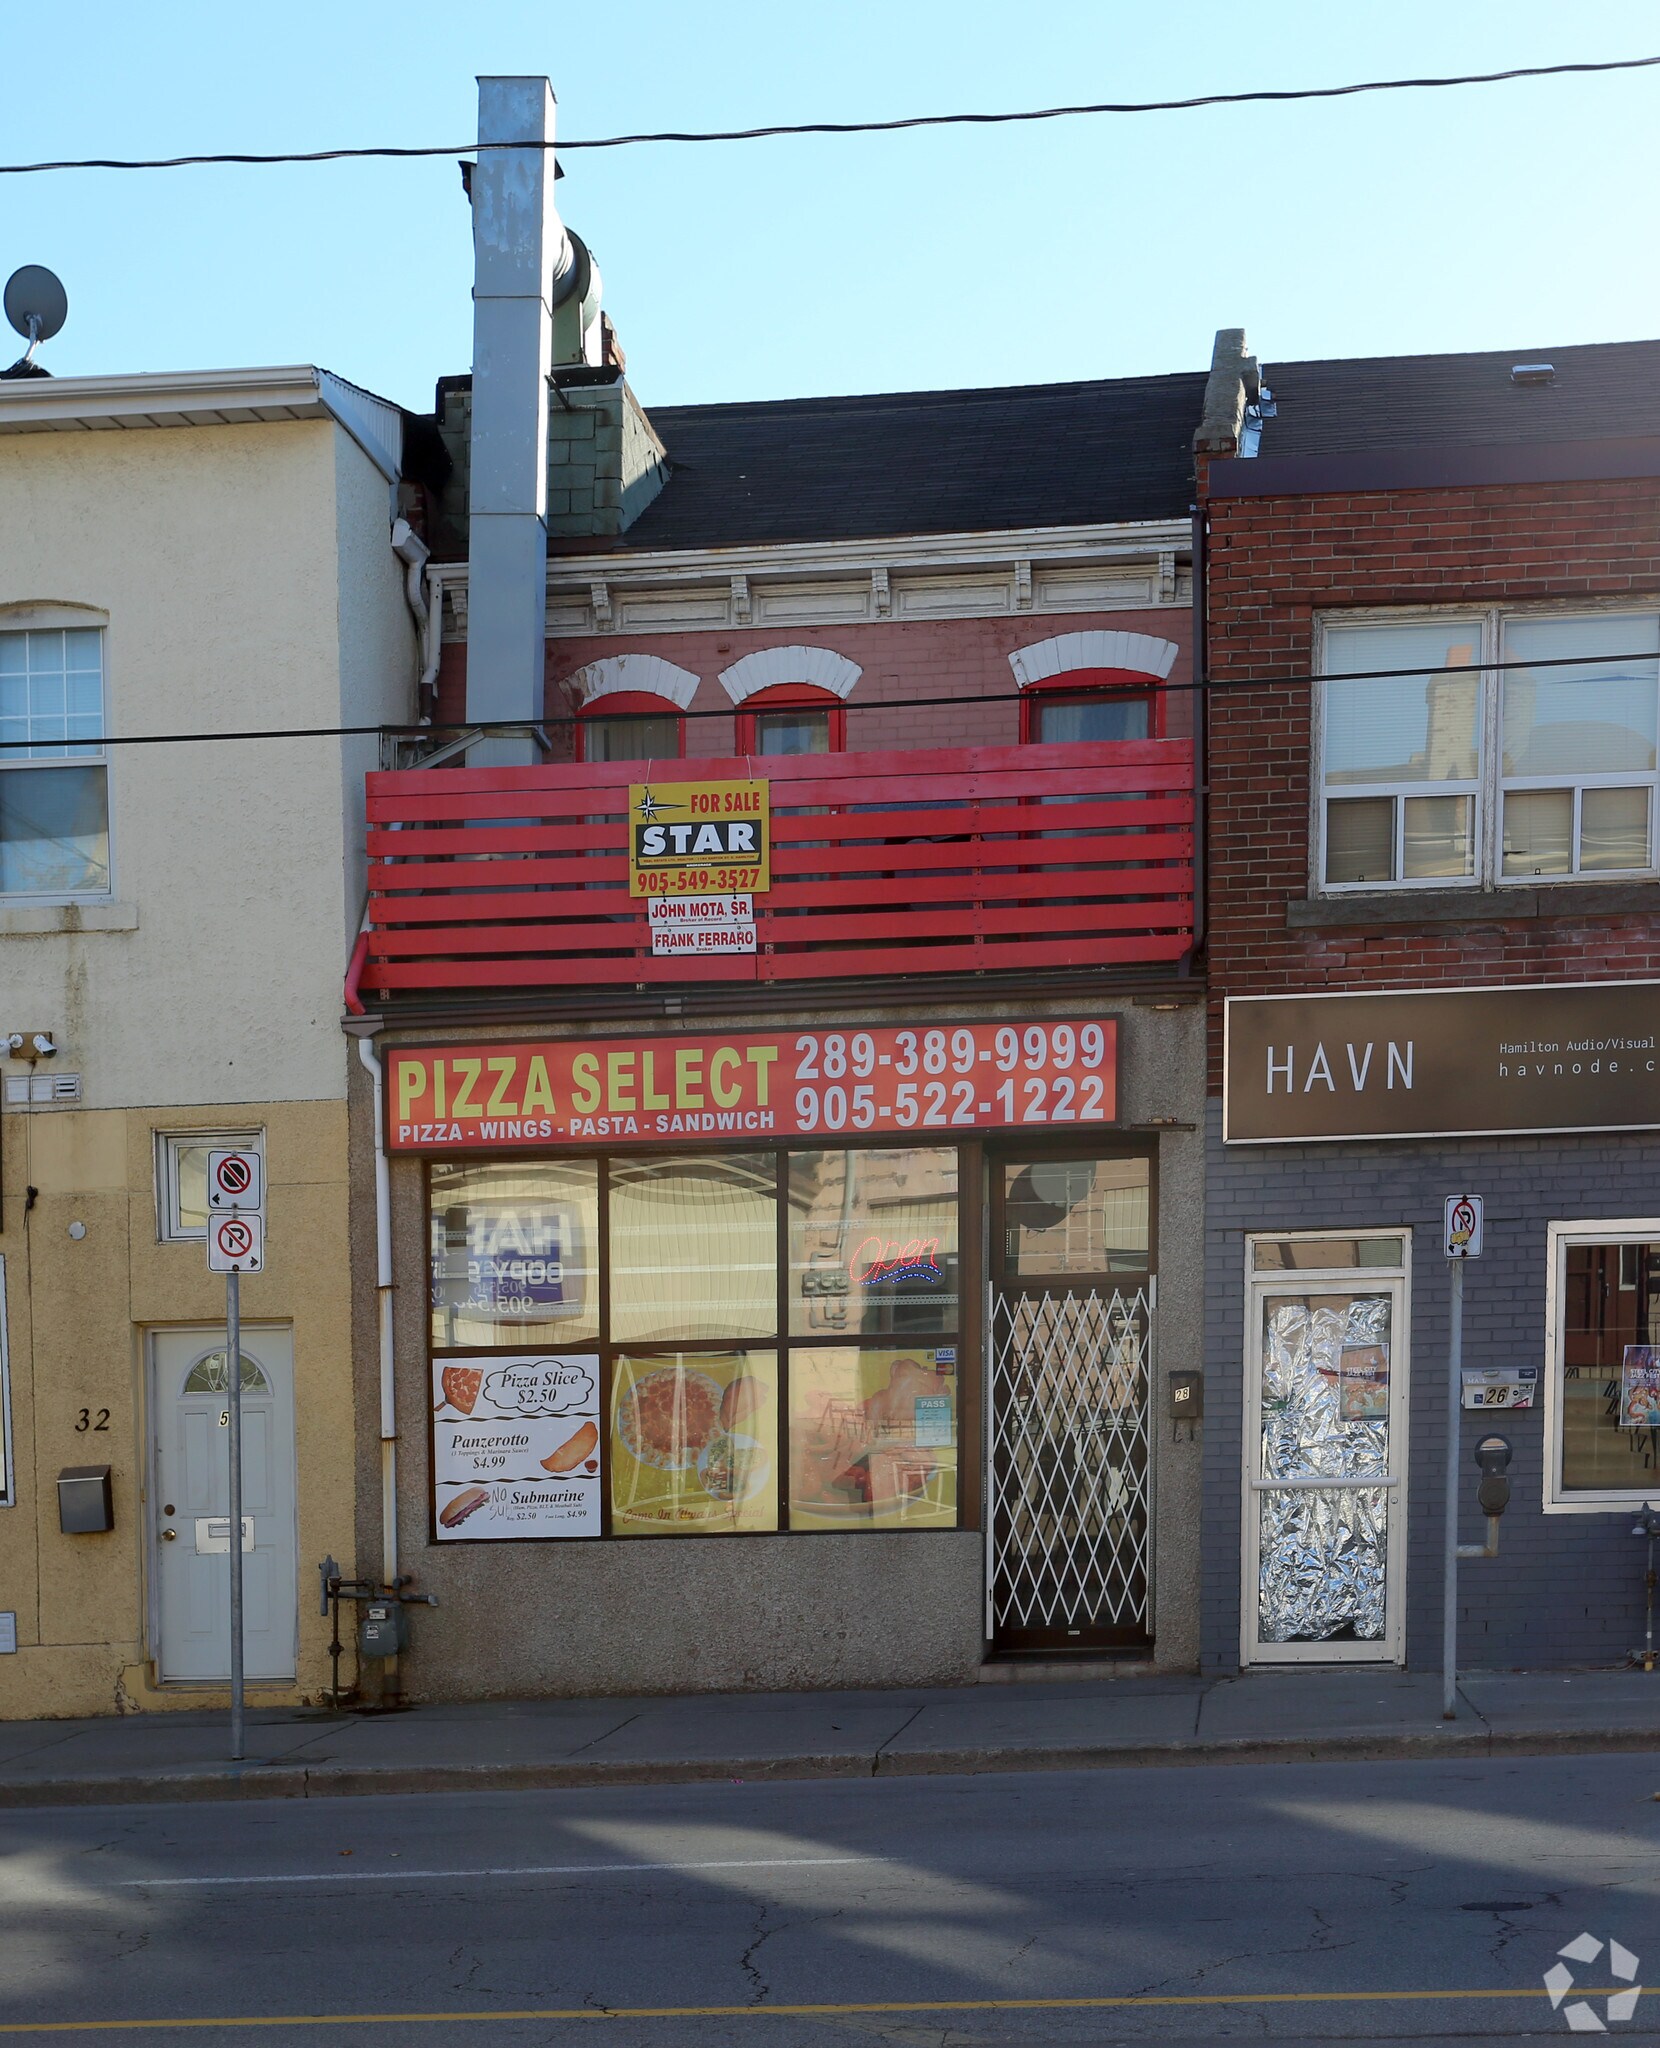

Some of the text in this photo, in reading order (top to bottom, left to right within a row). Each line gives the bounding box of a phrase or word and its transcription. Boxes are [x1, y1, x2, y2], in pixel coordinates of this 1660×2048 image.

[691, 791, 760, 813] FOR SALE
[642, 823, 755, 856] STAR
[638, 868, 760, 892] 905-549-3527
[652, 901, 750, 918] JOHN MOTA, SR.
[655, 931, 753, 948] FRANK FERRARO
[795, 1024, 1105, 1080] 289-389-9999
[1500, 1036, 1655, 1054] Hamilton Audio/Visual
[1267, 1041, 1414, 1094] HAVN
[398, 1046, 778, 1120] PIZZA SELECT
[795, 1075, 1104, 1131] 905-522-1222
[399, 1123, 463, 1143] PIZZA
[480, 1119, 552, 1140] WINGS
[570, 1116, 638, 1136] PASTA
[656, 1111, 774, 1133] SANDWICH
[850, 1236, 939, 1281] Open
[501, 1371, 579, 1388] Pizza Slice
[518, 1388, 557, 1404] $2.50
[1176, 1389, 1188, 1400] 28
[1486, 1389, 1506, 1403] 26
[921, 1400, 945, 1408] PASS
[75, 1408, 110, 1432] 32
[451, 1433, 529, 1449] Panzerotto
[473, 1456, 506, 1469] $4.99
[491, 1486, 507, 1504] NO
[511, 1489, 584, 1504] Submarine
[516, 1512, 537, 1520] $2.50
[567, 1509, 587, 1519] $4.99
